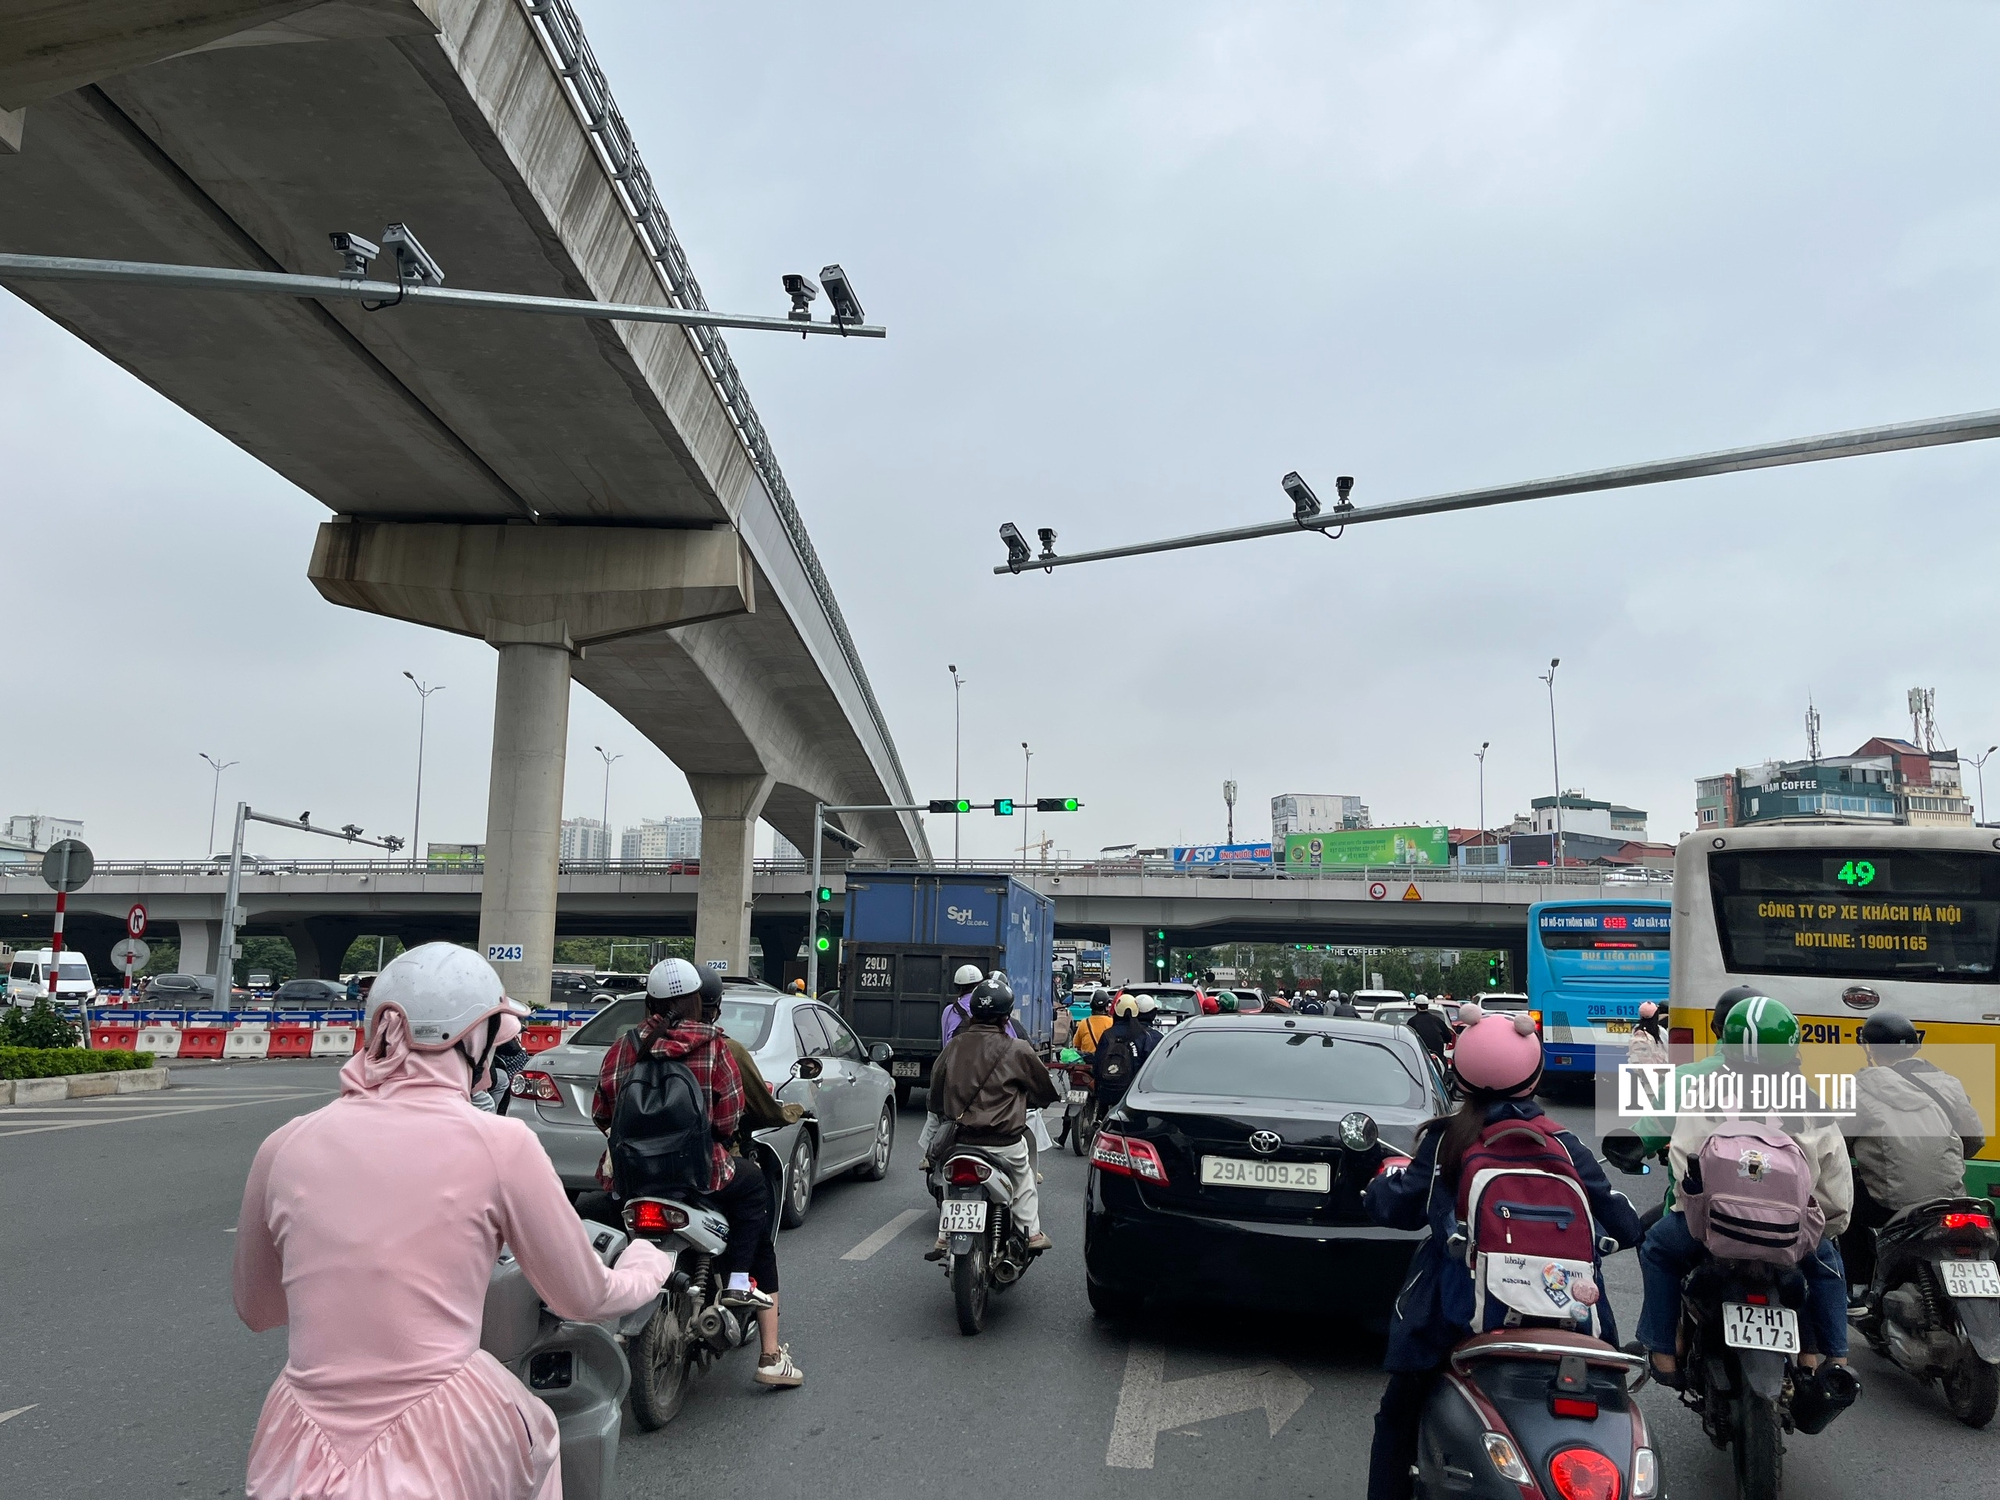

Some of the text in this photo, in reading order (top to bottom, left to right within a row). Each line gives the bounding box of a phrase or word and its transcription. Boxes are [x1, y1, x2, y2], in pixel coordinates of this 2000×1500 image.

[1761, 780, 1817, 794] TRẠM COFFEE
[999, 800, 1011, 815] 16
[1194, 848, 1216, 862] SP
[1254, 847, 1271, 858] SINO
[1837, 861, 1876, 887] 49
[1758, 901, 1961, 925] CÔNG TY CP XE KHÁCH HÀ NỘI
[1795, 932, 1927, 950] HOTLINE: 19001165
[489, 946, 522, 960] P243
[707, 961, 727, 970] P242
[865, 956, 888, 970] 29LD
[861, 973, 892, 987] 323.74
[1587, 1005, 1606, 1015] 29B
[1616, 1005, 1639, 1016] 613.
[1801, 1024, 1840, 1044] 29H
[1212, 1161, 1318, 1186] 29A-009.26
[949, 1203, 979, 1216] 19-S1
[942, 1216, 982, 1230] 012.54
[1950, 1263, 1990, 1278] 29-L5
[1949, 1279, 1999, 1294] 381.45
[1736, 1305, 1783, 1328] 12-H1
[1730, 1324, 1794, 1349] 141.73
